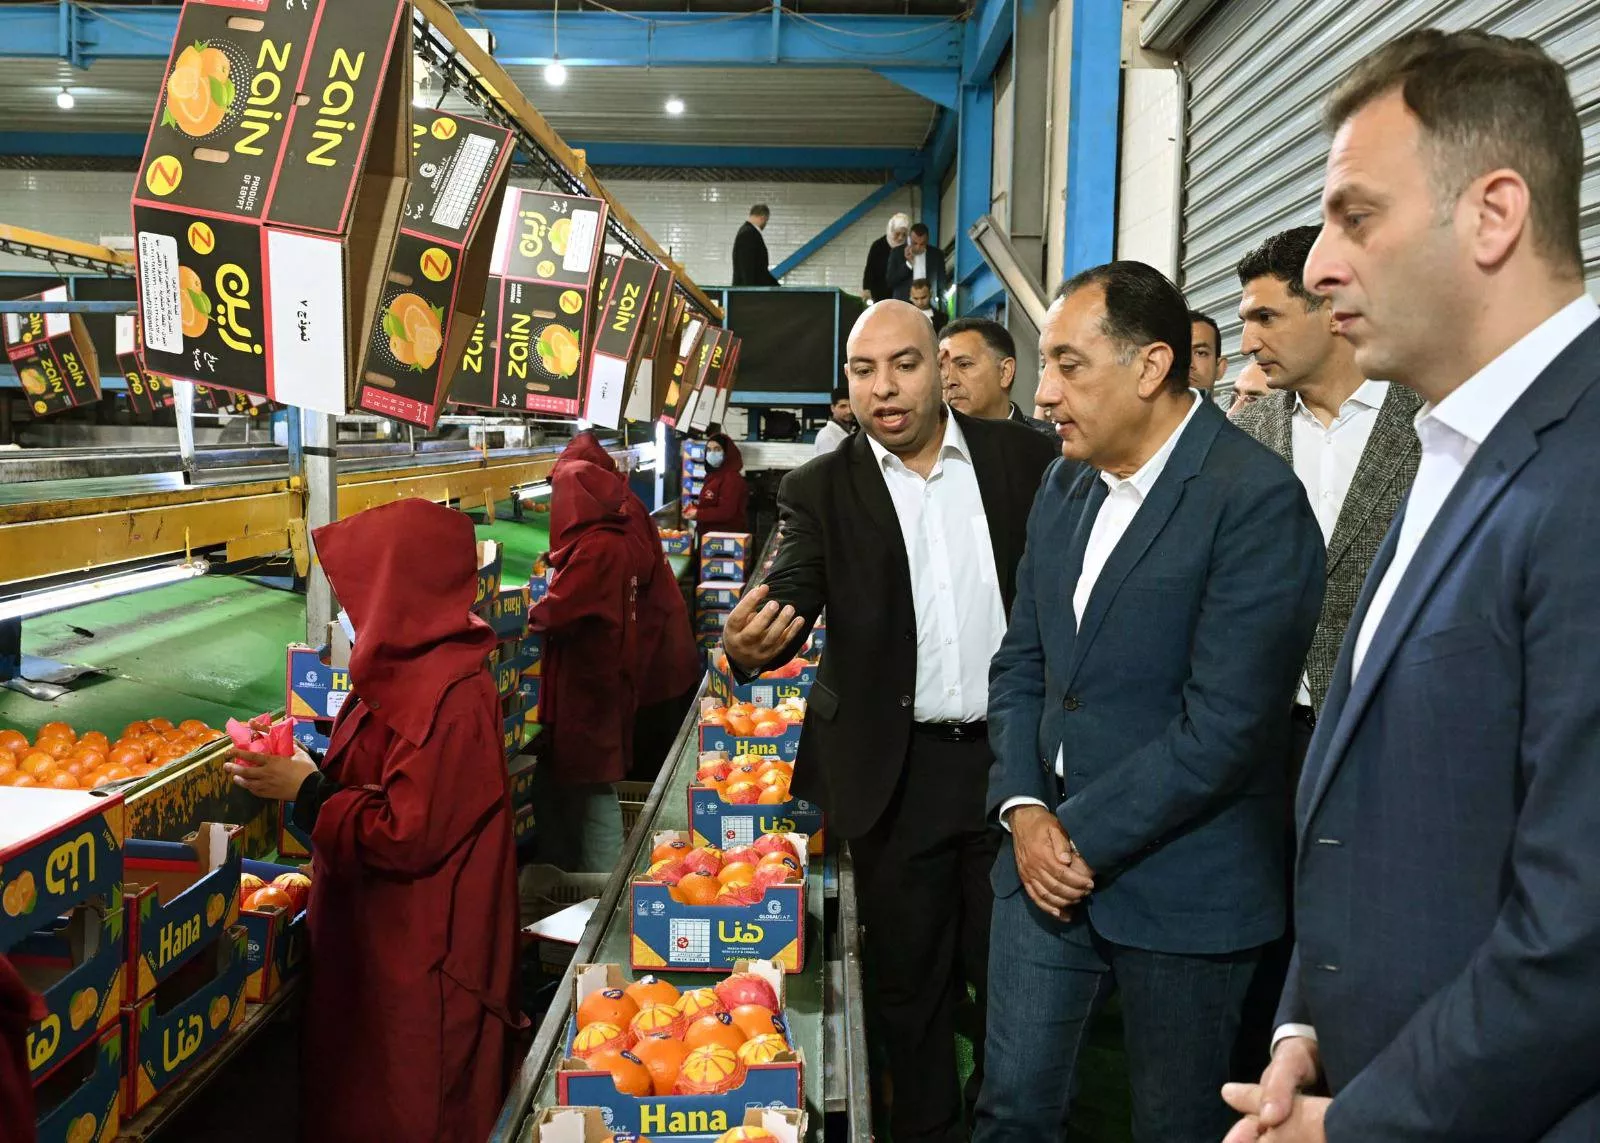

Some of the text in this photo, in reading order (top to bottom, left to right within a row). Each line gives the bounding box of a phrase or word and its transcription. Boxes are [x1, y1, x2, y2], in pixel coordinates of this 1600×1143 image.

[236, 174, 251, 210] OF EGYPT
[248, 175, 261, 212] PRODUCE
[215, 263, 262, 354] زين
[776, 686, 800, 698] هنا
[736, 740, 777, 755] Hana
[760, 816, 796, 834] هنا
[45, 831, 95, 895] هنا
[159, 912, 200, 969] Hana
[248, 943, 260, 952] SO
[718, 920, 764, 943] هنا
[163, 1014, 204, 1072] هنا
[640, 1103, 727, 1133] Hana
